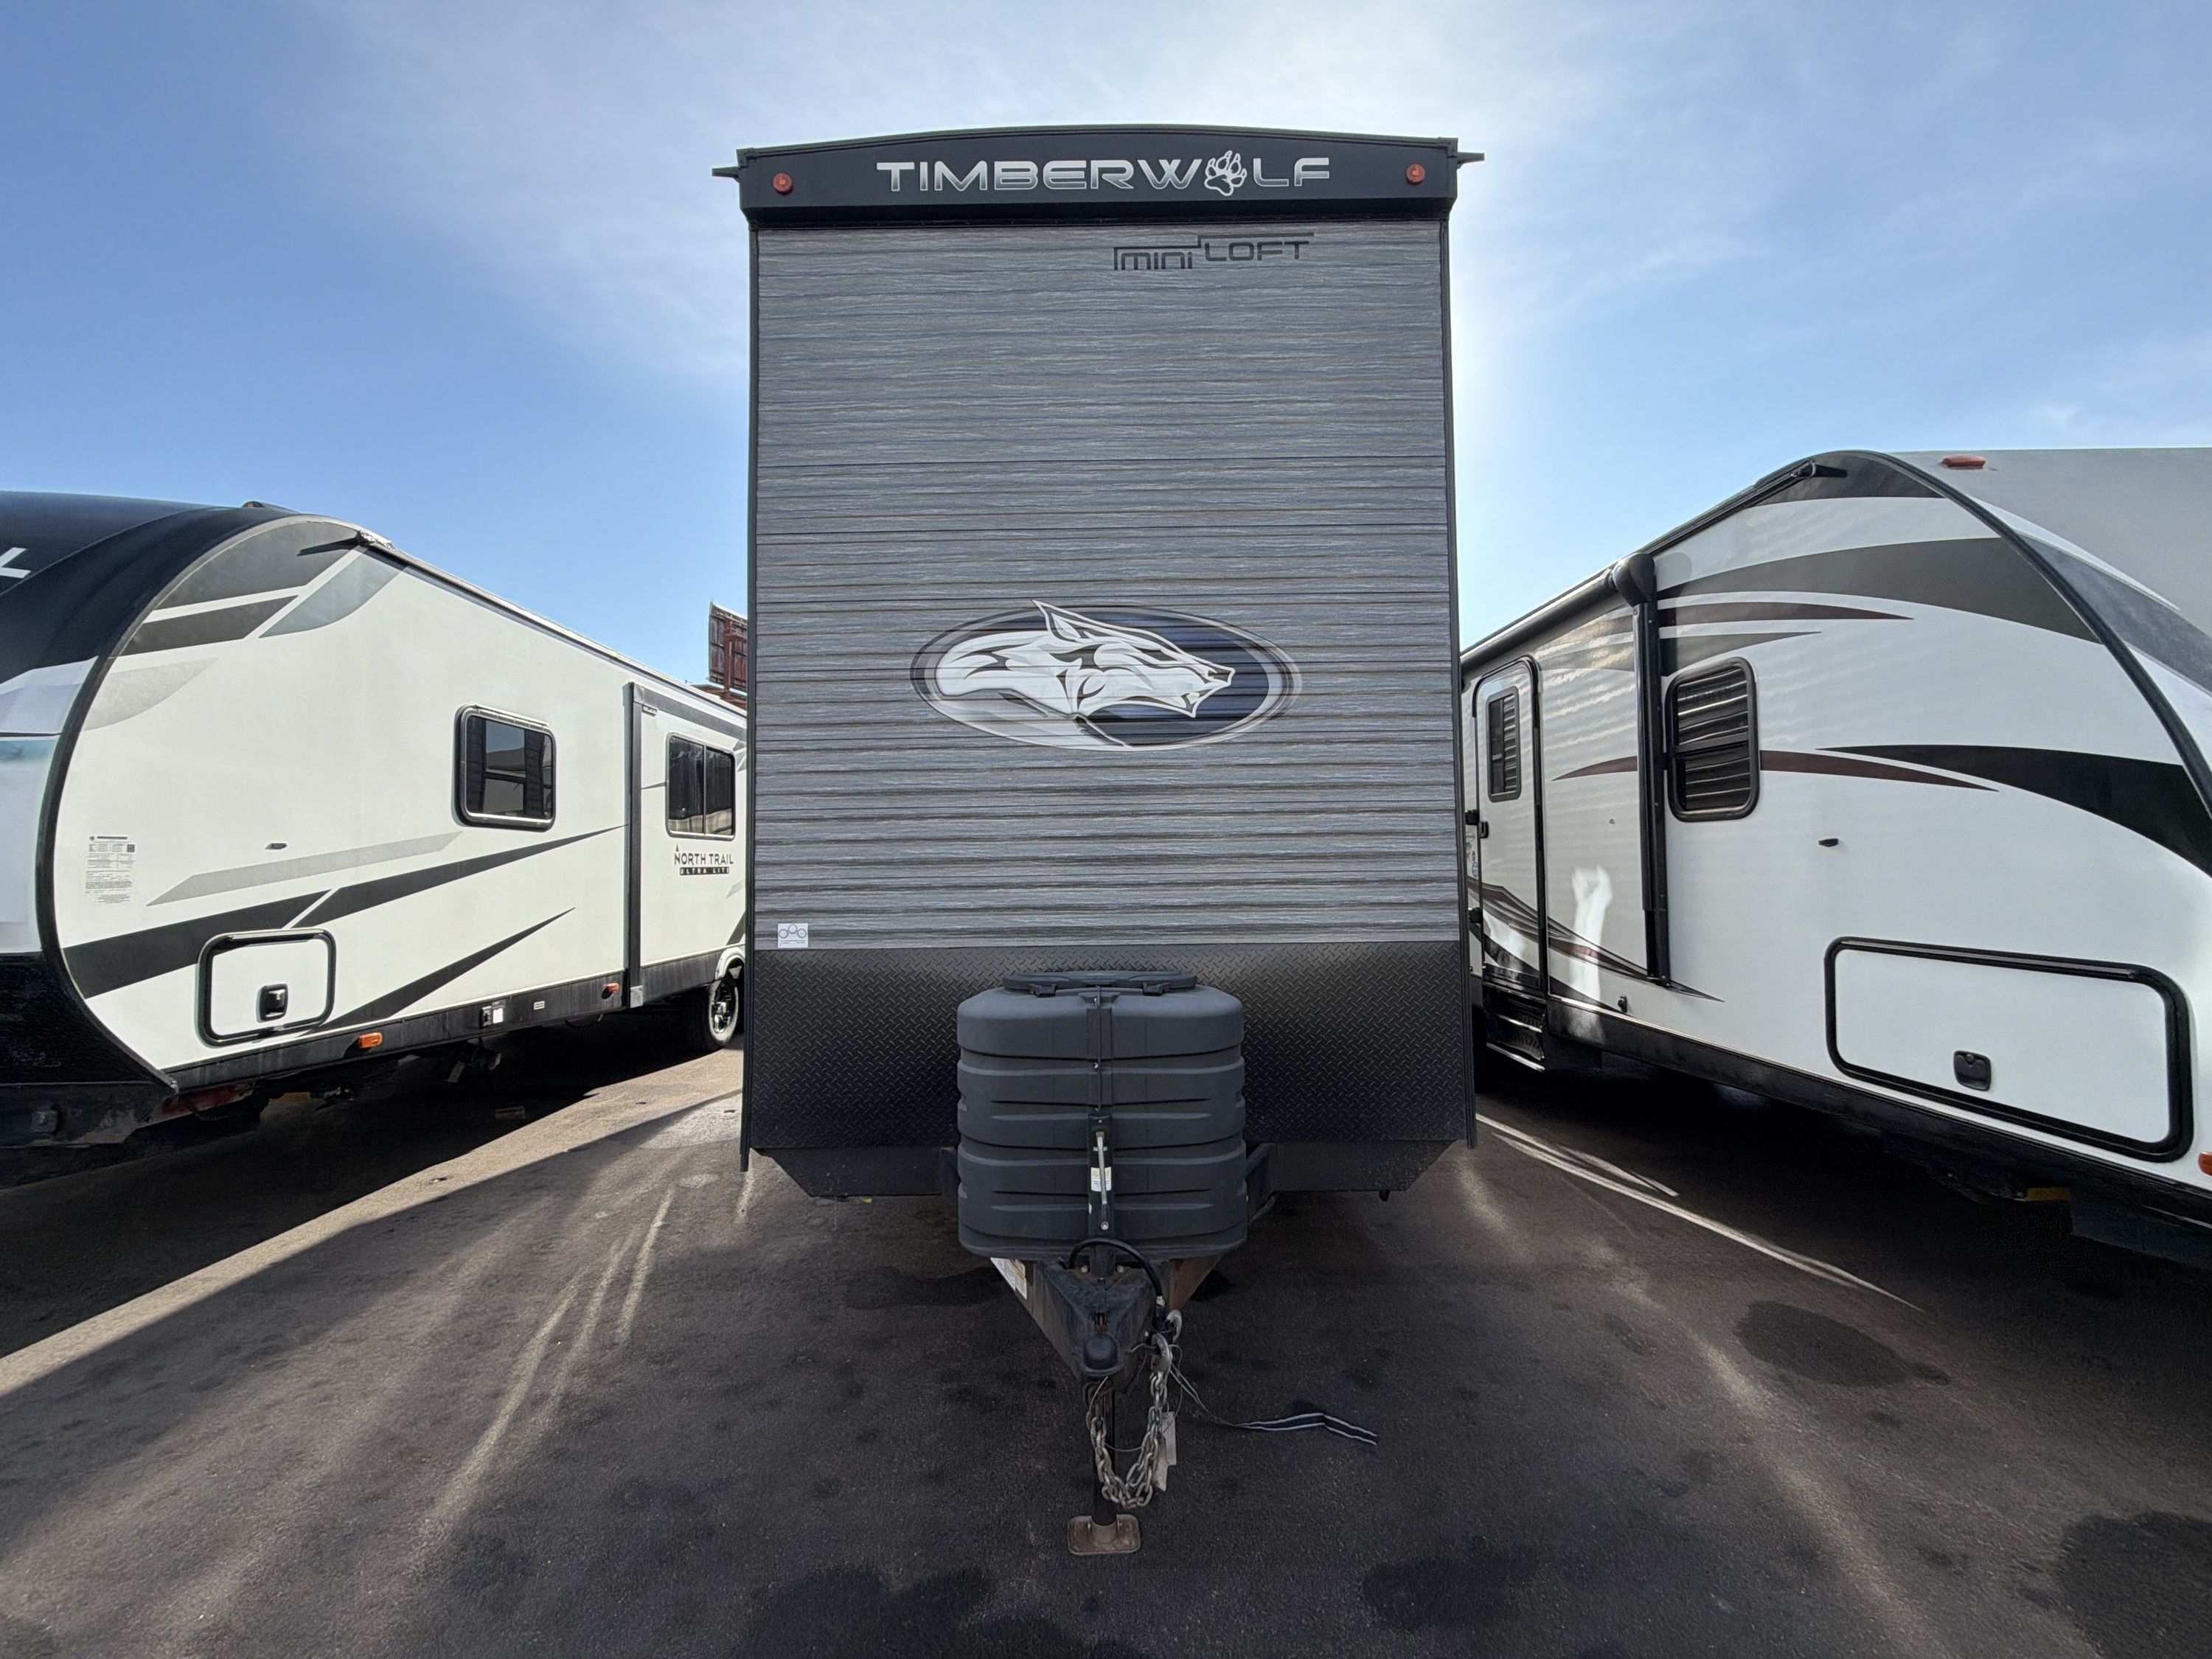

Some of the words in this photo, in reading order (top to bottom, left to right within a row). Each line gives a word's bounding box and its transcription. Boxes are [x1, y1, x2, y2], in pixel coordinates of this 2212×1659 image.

[1204, 240, 1310, 262] LOFT
[674, 852, 706, 866] NORTH
[709, 852, 734, 866] TRAIL
